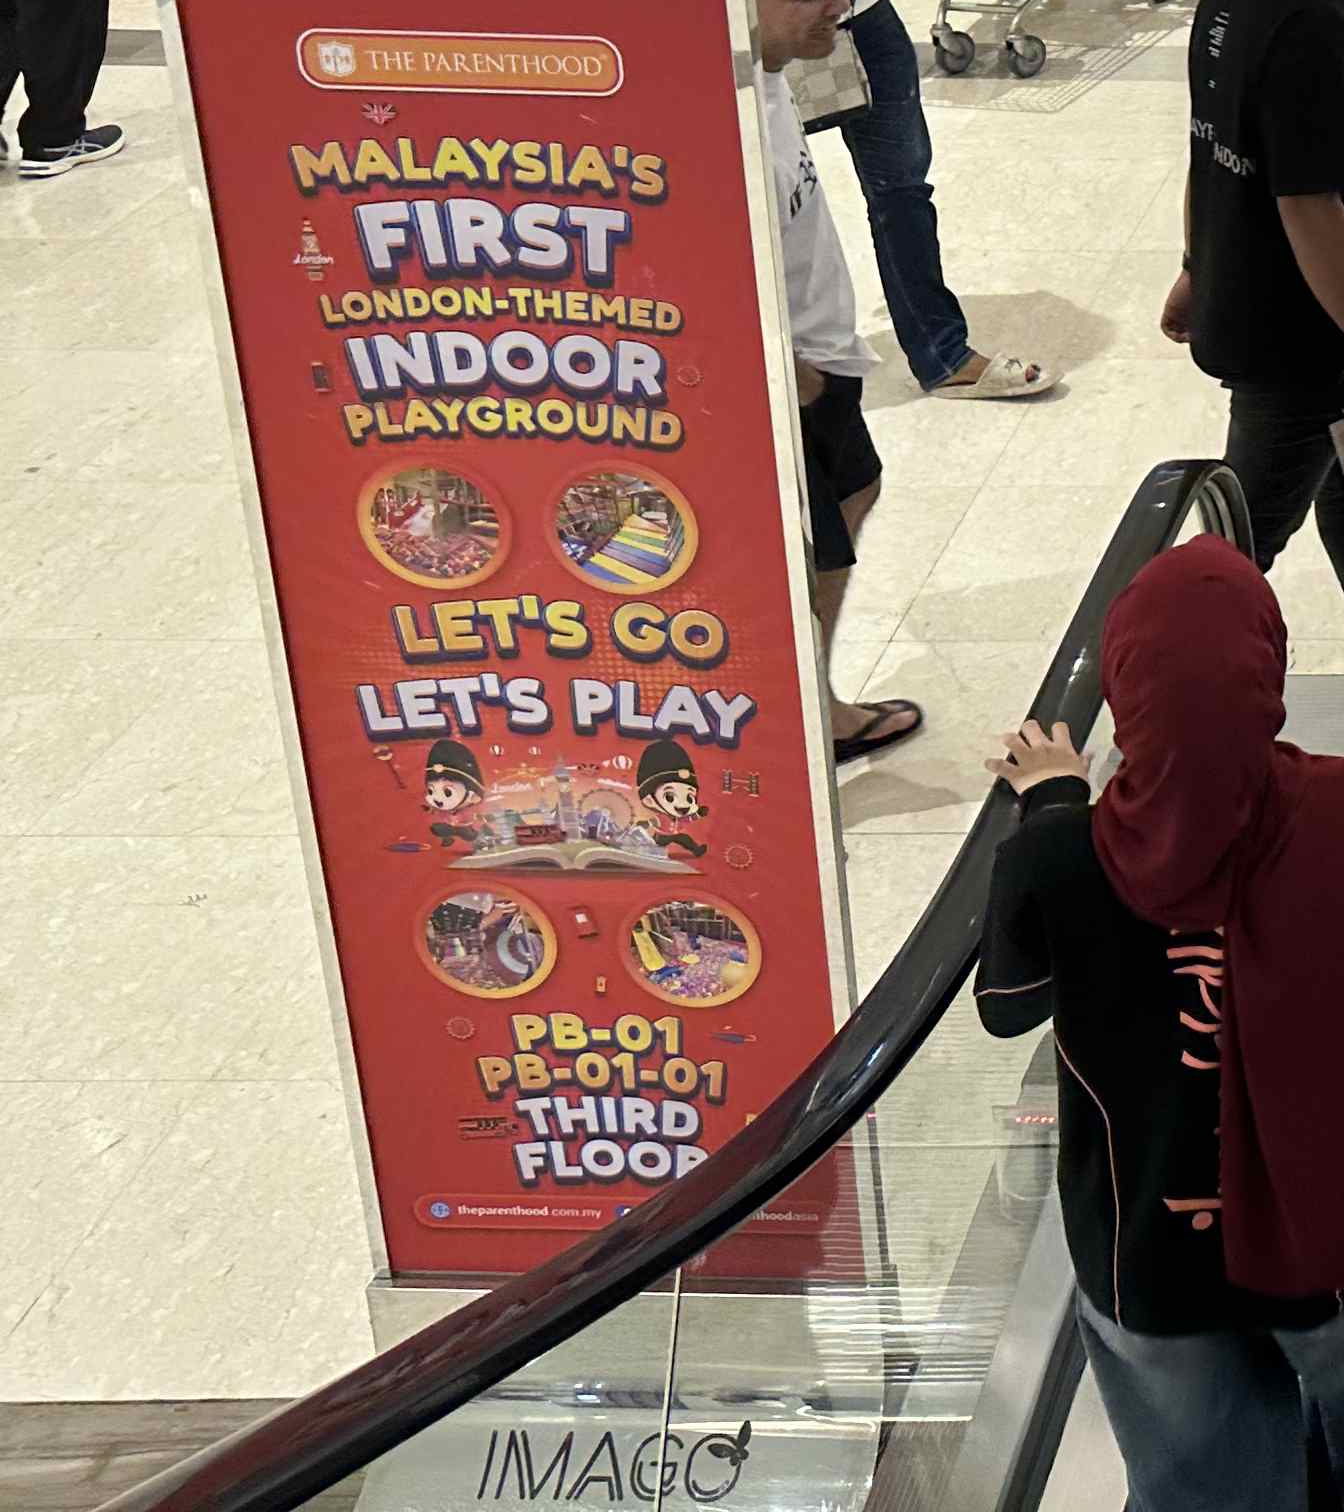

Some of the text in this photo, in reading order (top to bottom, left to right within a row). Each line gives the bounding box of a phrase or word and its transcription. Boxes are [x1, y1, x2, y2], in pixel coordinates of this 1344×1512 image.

[366, 49, 602, 76] THE PARENTHOOD
[291, 136, 668, 198] MALAYSIA'S
[293, 252, 334, 265] London
[355, 197, 628, 276] FIRST
[320, 286, 683, 334] LONDON-THEMED
[345, 331, 666, 398] INDOOR
[344, 397, 684, 449] PLAYGROUND
[393, 595, 728, 664] LET'S GO
[357, 673, 756, 745] LET'S PLAY
[511, 1013, 682, 1056] PB-01
[478, 1055, 728, 1099] PB-01-01
[515, 1095, 701, 1140] THIRD
[457, 1205, 602, 1219] theparenthood.com.my
[477, 1428, 745, 1504] IMAGO
